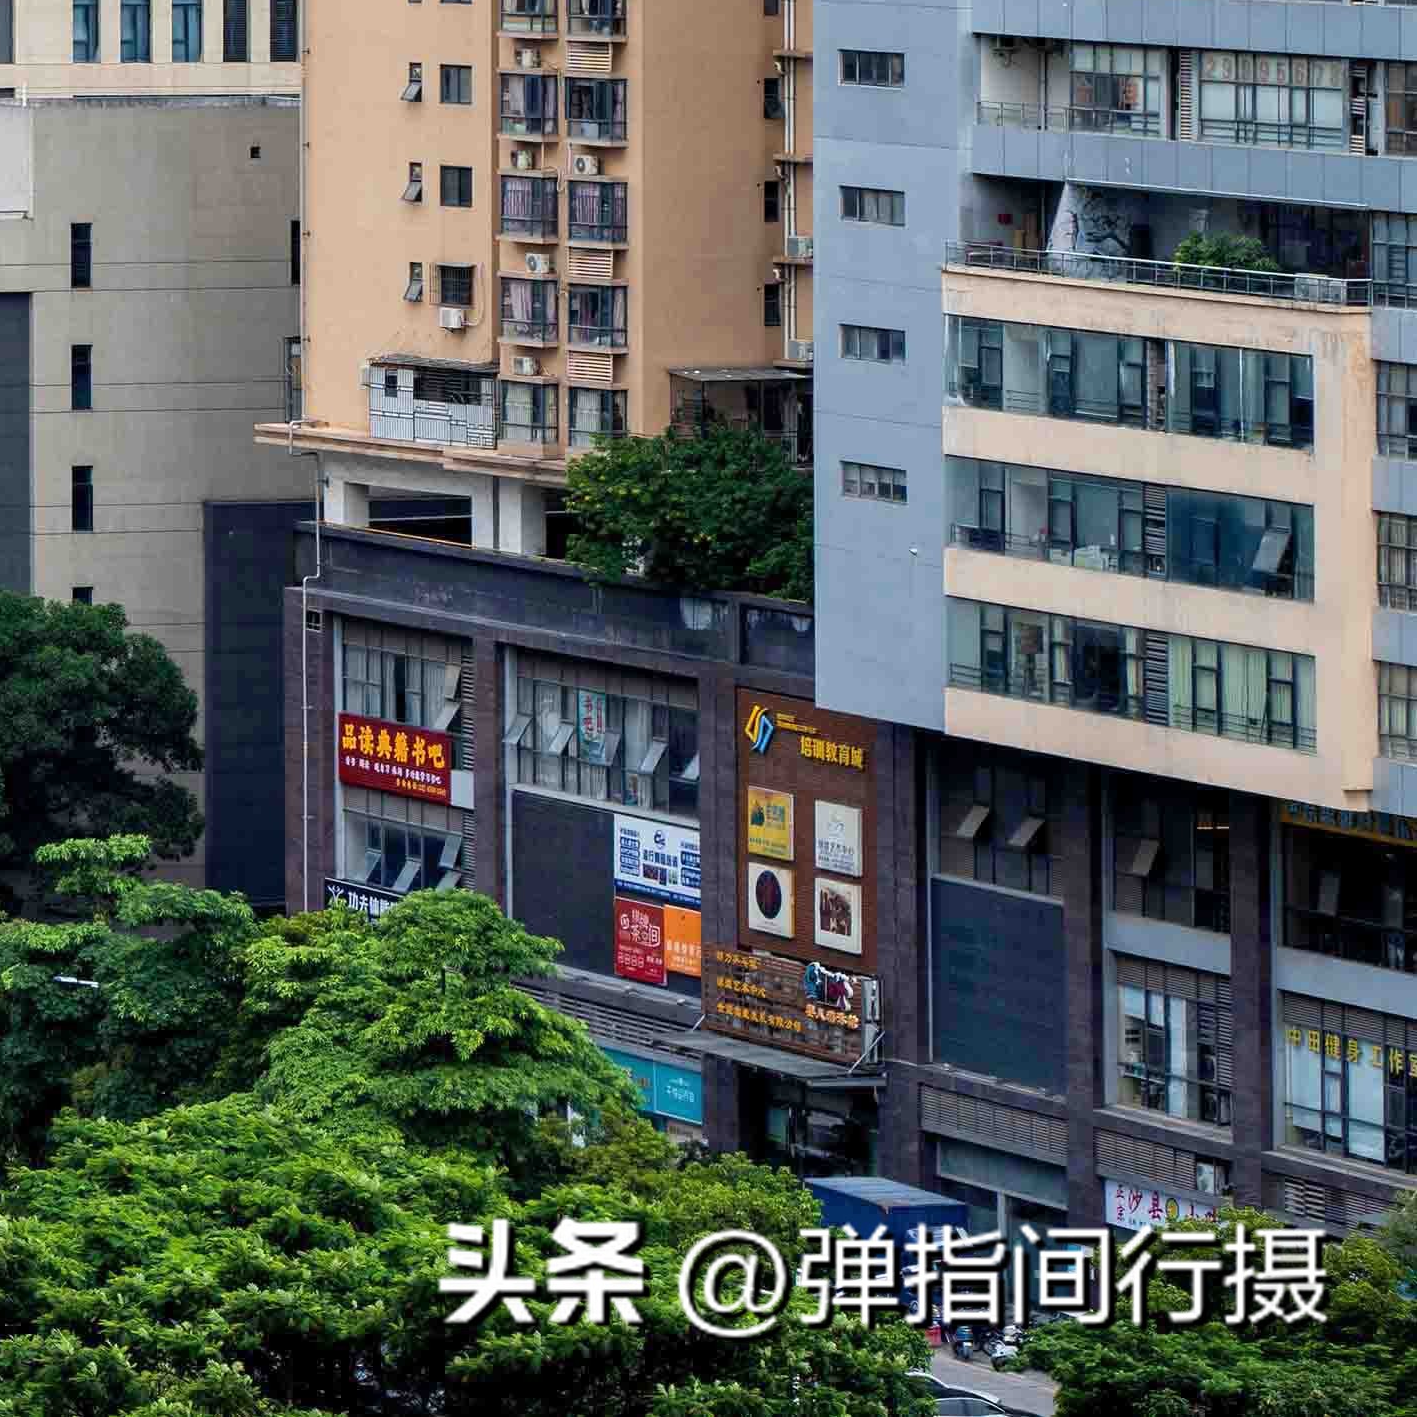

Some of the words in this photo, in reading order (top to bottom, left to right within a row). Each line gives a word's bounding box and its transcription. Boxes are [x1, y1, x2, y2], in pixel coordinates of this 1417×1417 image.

[341, 723, 446, 769] 品读典籍书吧
